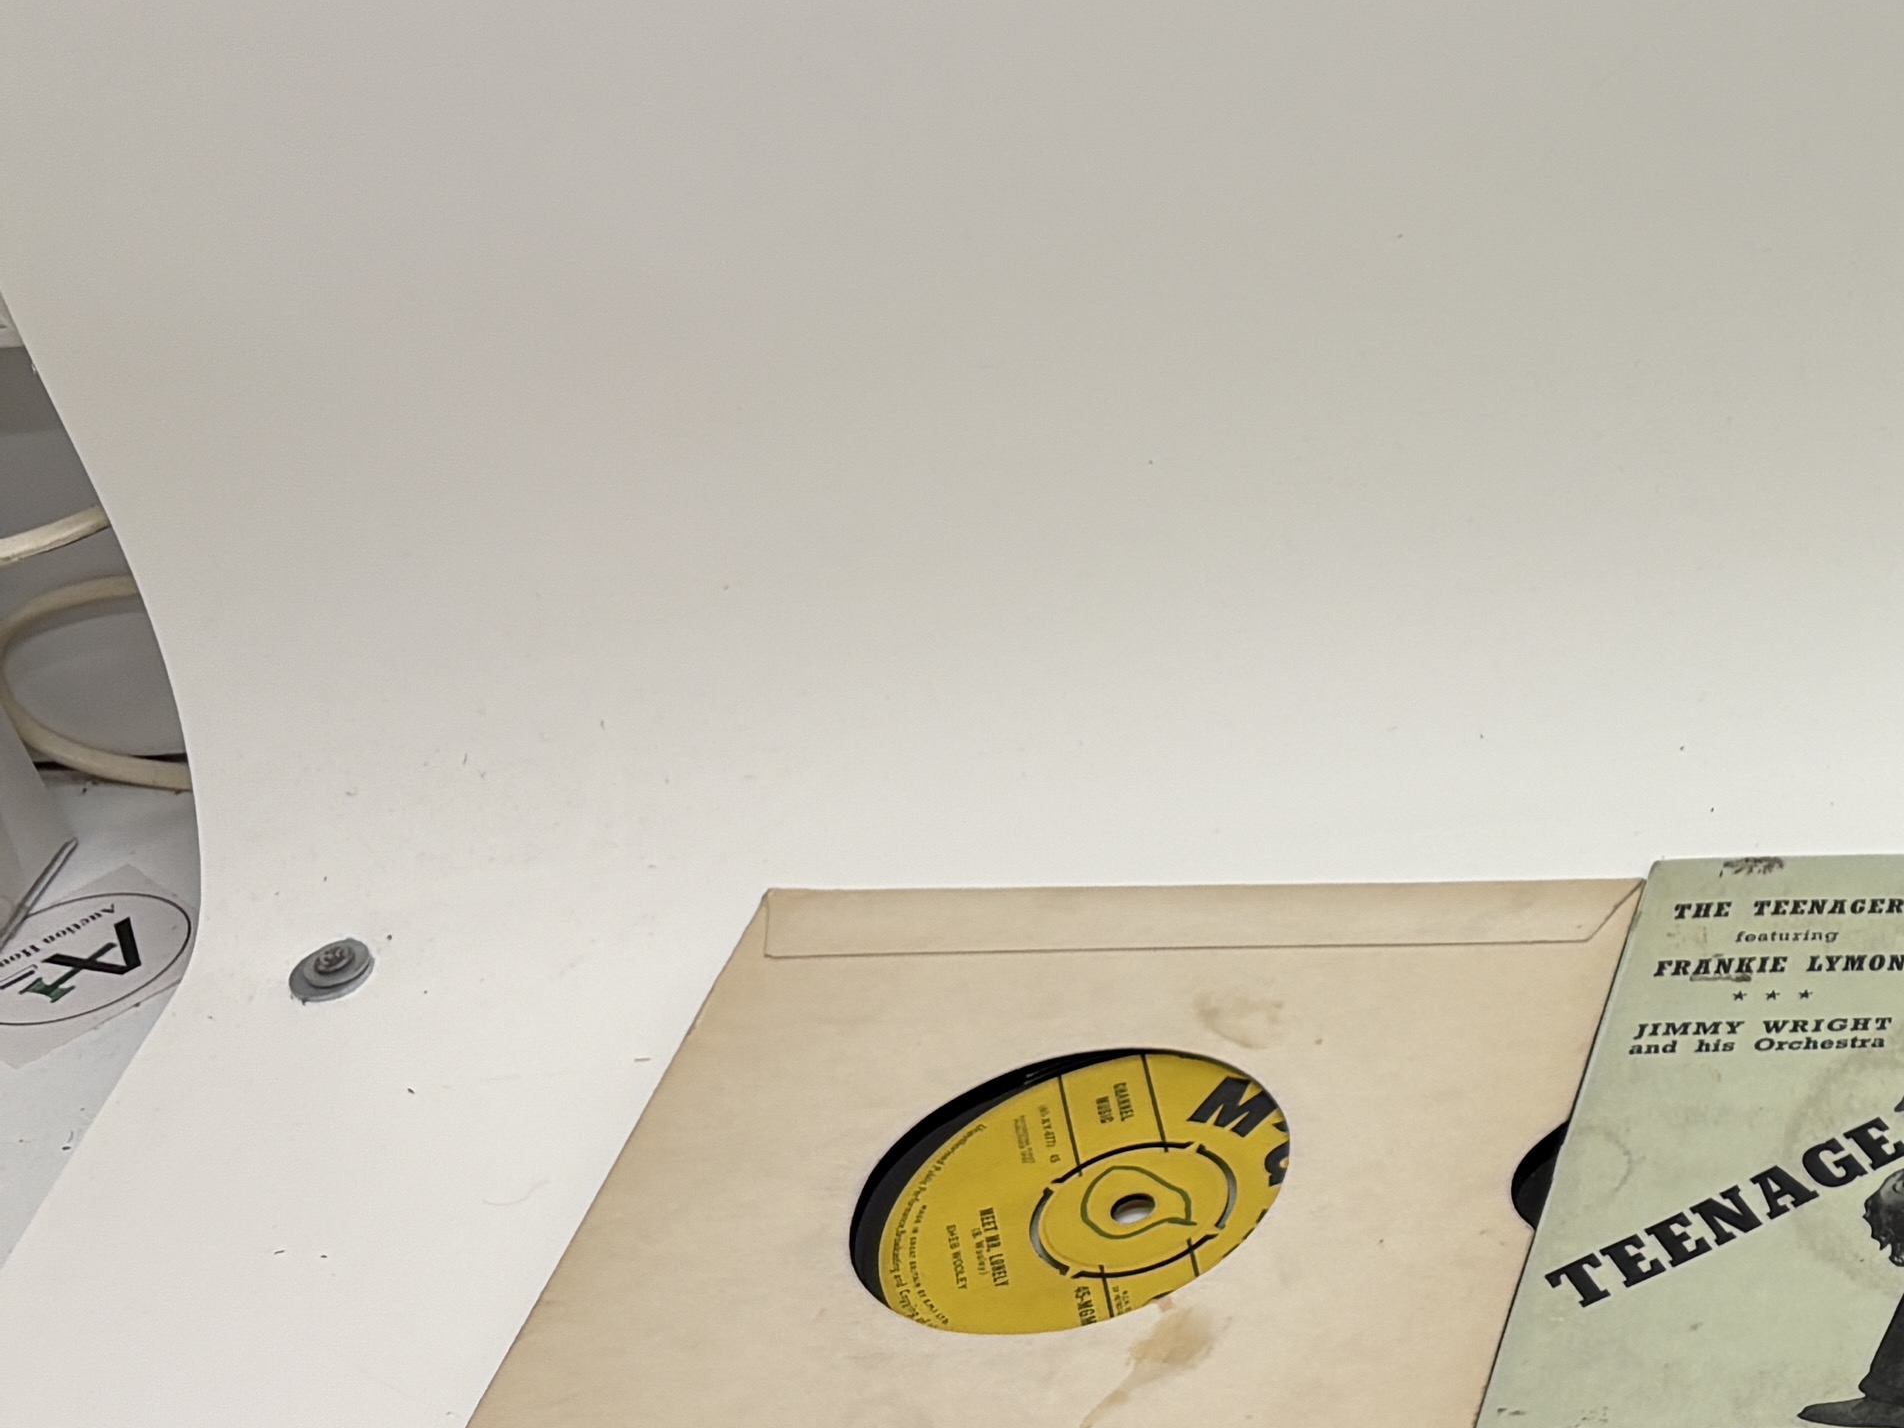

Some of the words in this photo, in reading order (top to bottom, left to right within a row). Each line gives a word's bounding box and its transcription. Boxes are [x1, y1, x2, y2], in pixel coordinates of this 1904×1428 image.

[1674, 900, 1732, 920] THE
[1734, 929, 1840, 945] featuring
[1653, 955, 1789, 978] FRANKIE
[1632, 1020, 1745, 1041] JIMMY
[1762, 1016, 1893, 1034] WRIGHT
[1628, 1039, 1678, 1056] and
[1693, 1038, 1736, 1054] his
[1753, 1034, 1885, 1053] Orchestra
[979, 1207, 998, 1232] MEET
[951, 1251, 969, 1290] WOOLEY
